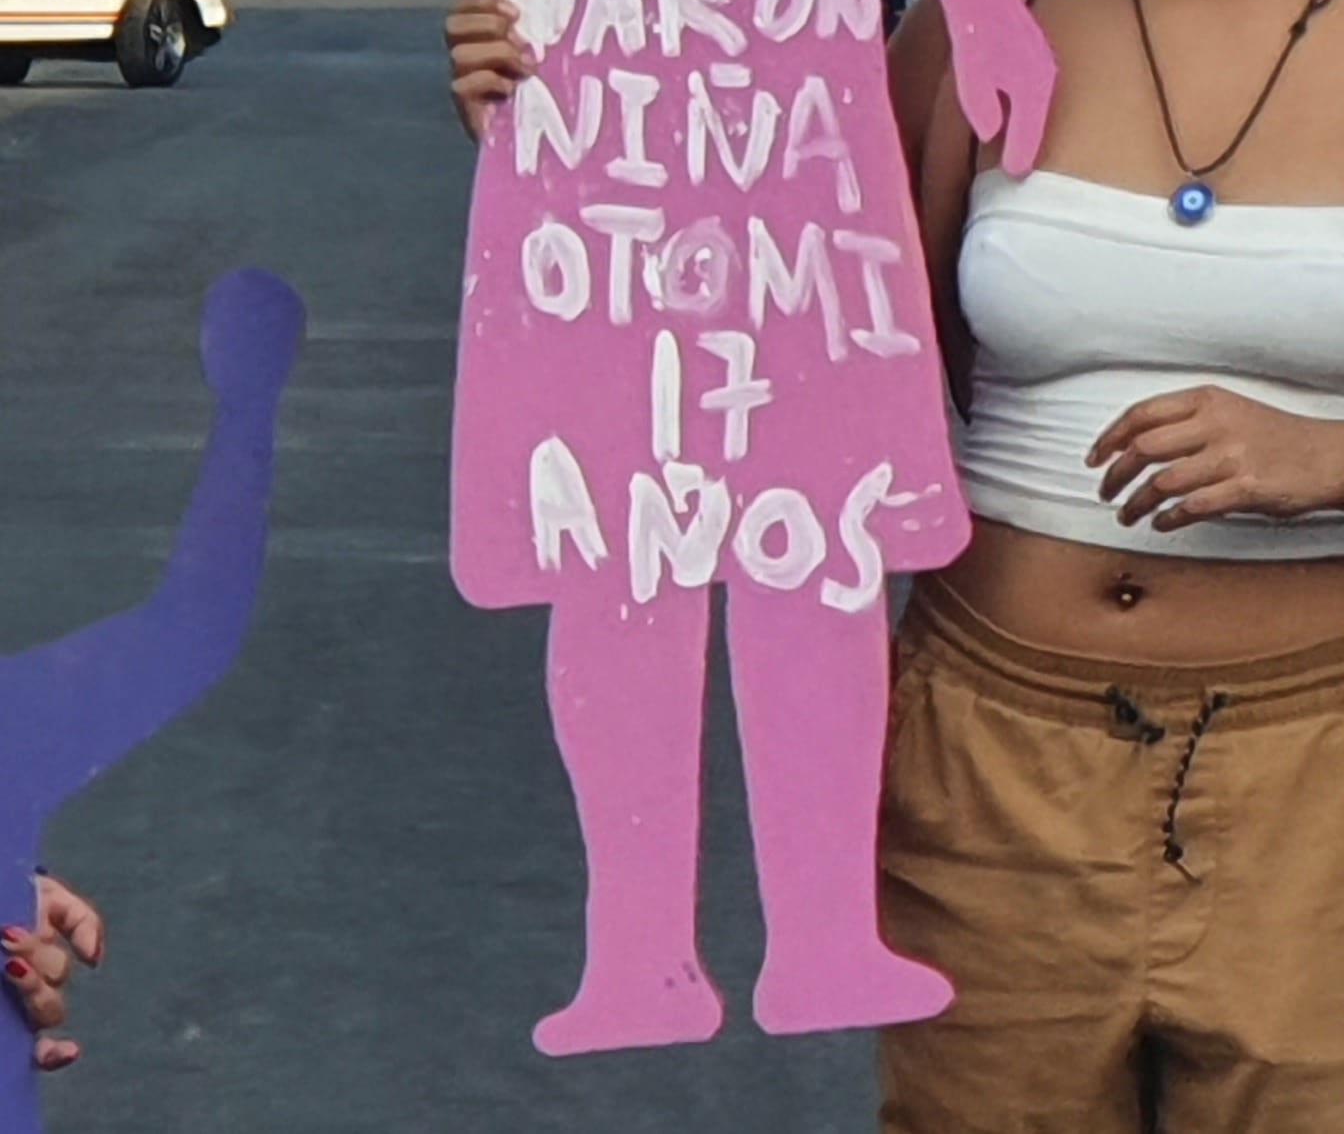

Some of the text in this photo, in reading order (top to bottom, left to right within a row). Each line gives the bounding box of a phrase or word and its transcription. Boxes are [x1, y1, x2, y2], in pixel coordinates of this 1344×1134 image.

[514, 63, 862, 213] NIÑA
[521, 204, 921, 362] OTOMI
[651, 329, 774, 462] 17
